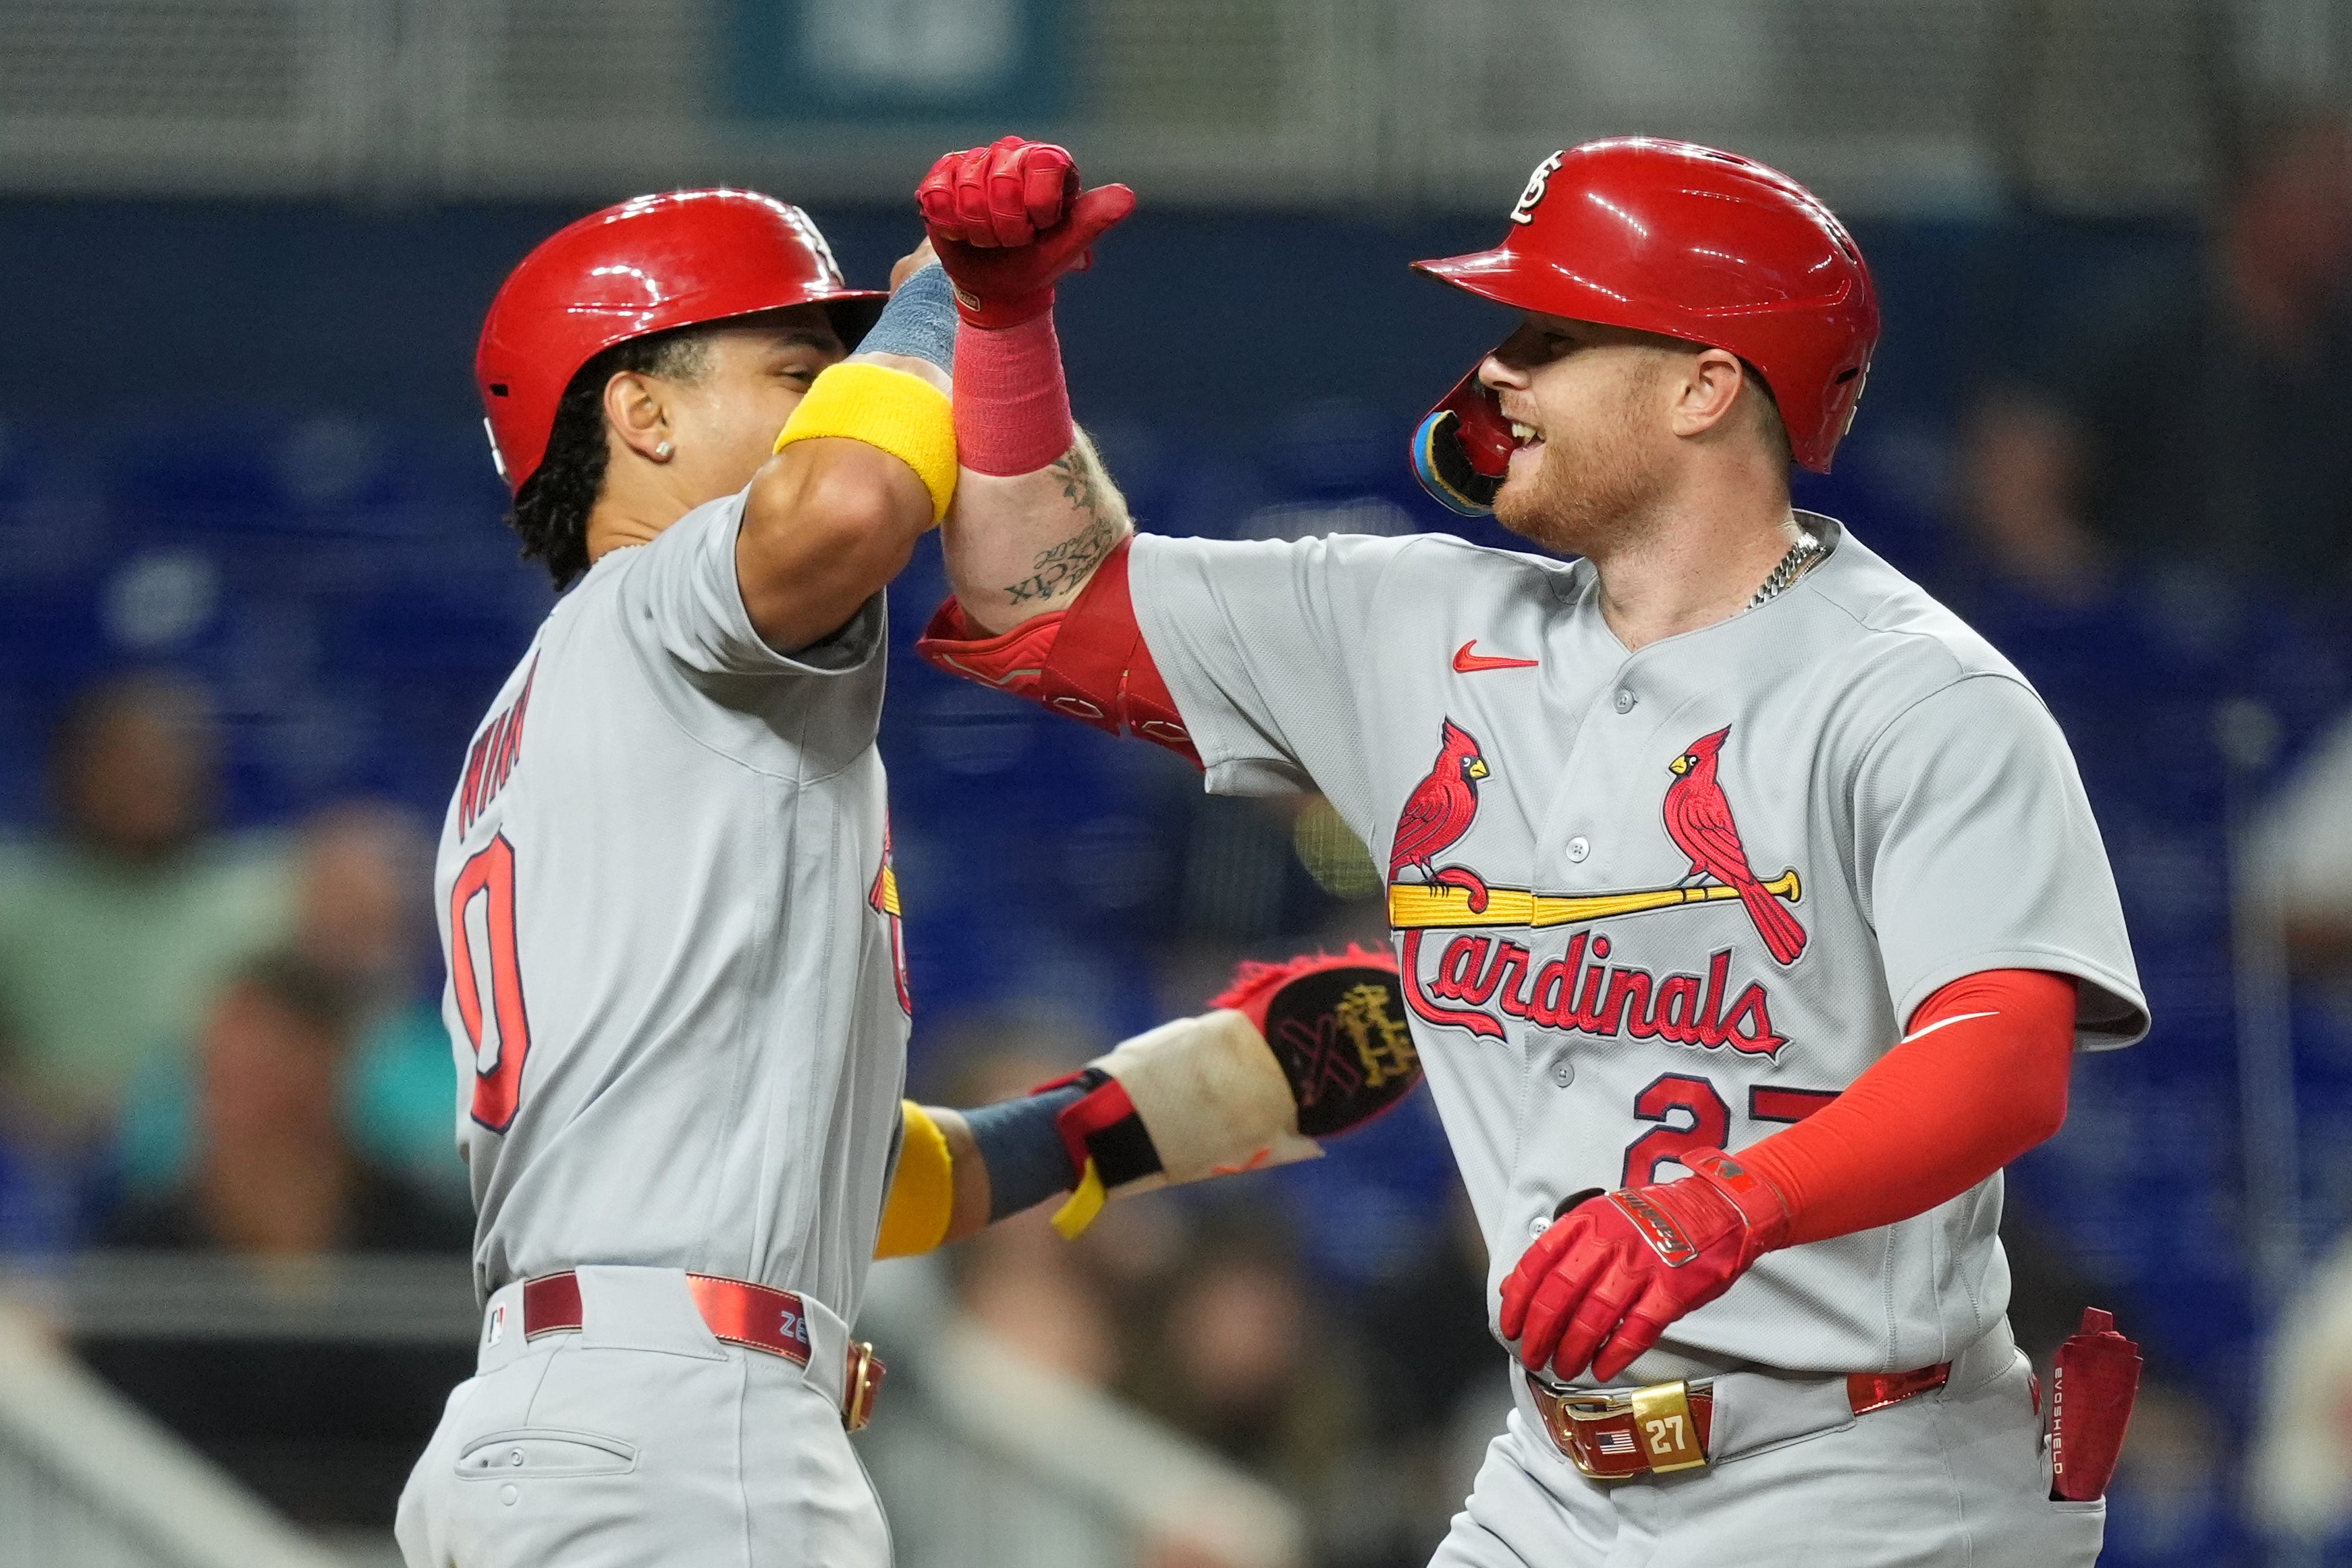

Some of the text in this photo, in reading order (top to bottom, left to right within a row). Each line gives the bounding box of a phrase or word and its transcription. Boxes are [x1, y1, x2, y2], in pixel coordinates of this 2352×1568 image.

[451, 824, 532, 1135] 0
[1402, 928, 1792, 1063] Cardinals
[1617, 1192, 1692, 1254] Franklin
[1645, 1415, 1686, 1455] 27
[2053, 1367, 2063, 1475] EVOSHIELD
